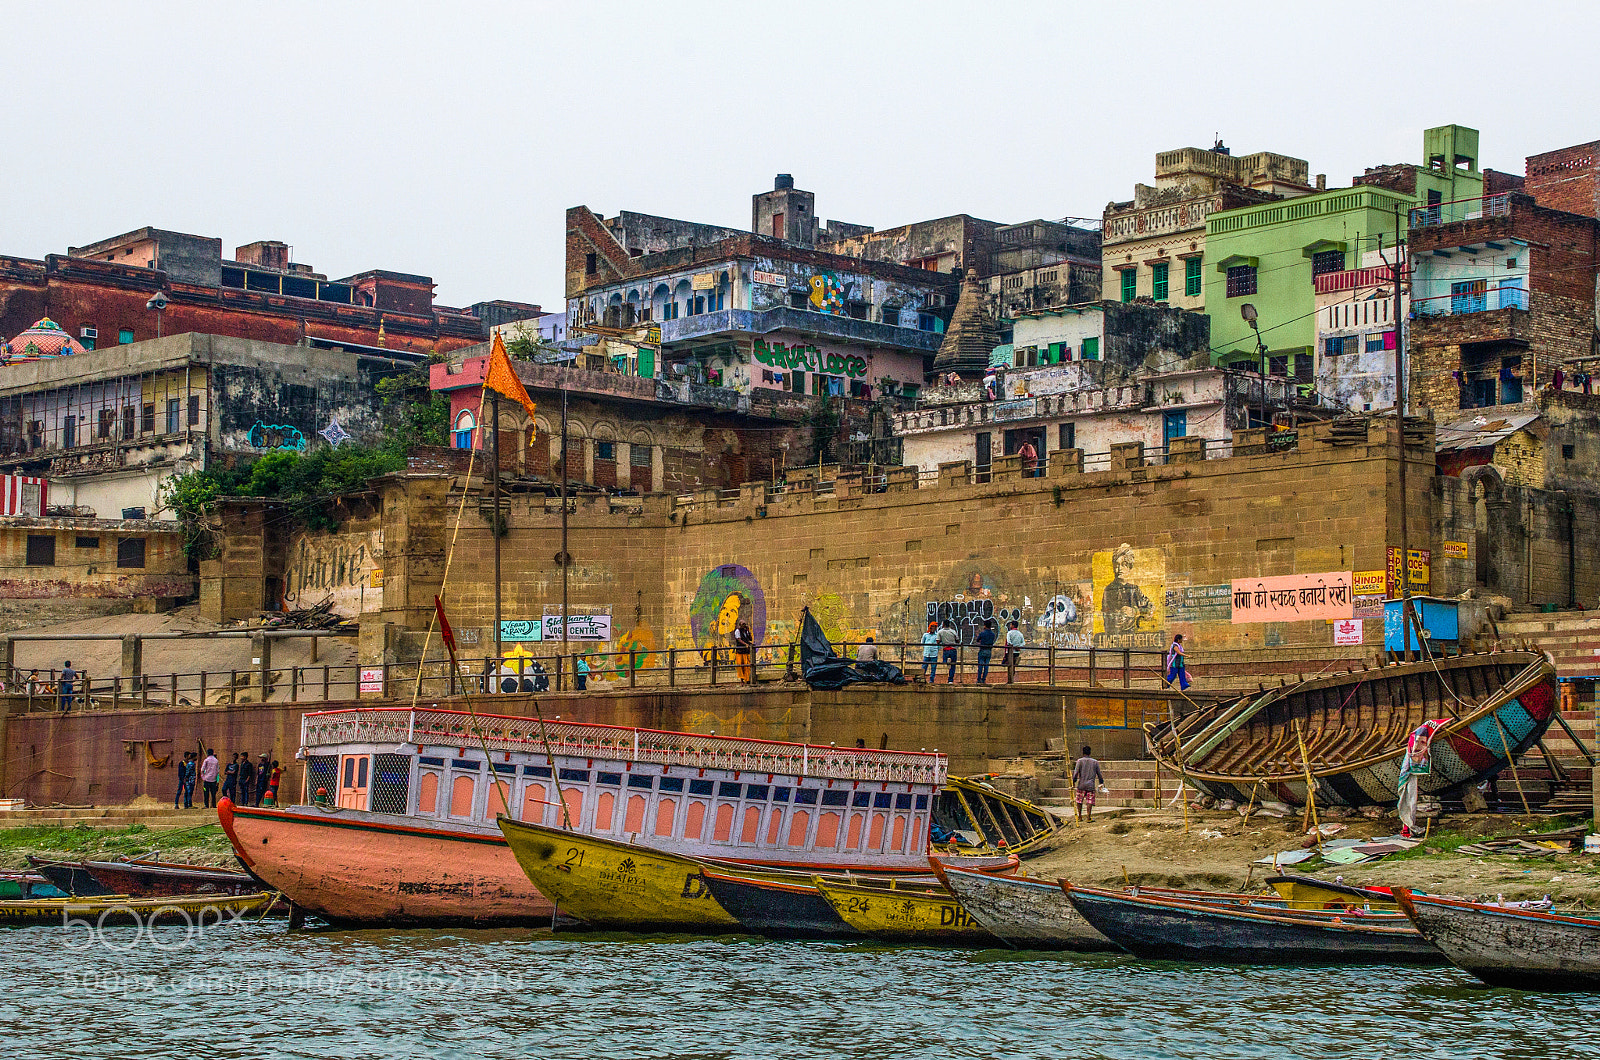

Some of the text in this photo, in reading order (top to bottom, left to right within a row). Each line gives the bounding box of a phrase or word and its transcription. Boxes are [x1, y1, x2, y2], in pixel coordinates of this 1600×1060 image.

[1444, 544, 1463, 552] HINDI
[1354, 575, 1380, 585] HINDI
[1234, 588, 1252, 609] गंगा
[1254, 583, 1268, 609] को
[549, 627, 599, 635] YOG CENTRE
[565, 847, 586, 867] 21
[848, 897, 870, 914] 24
